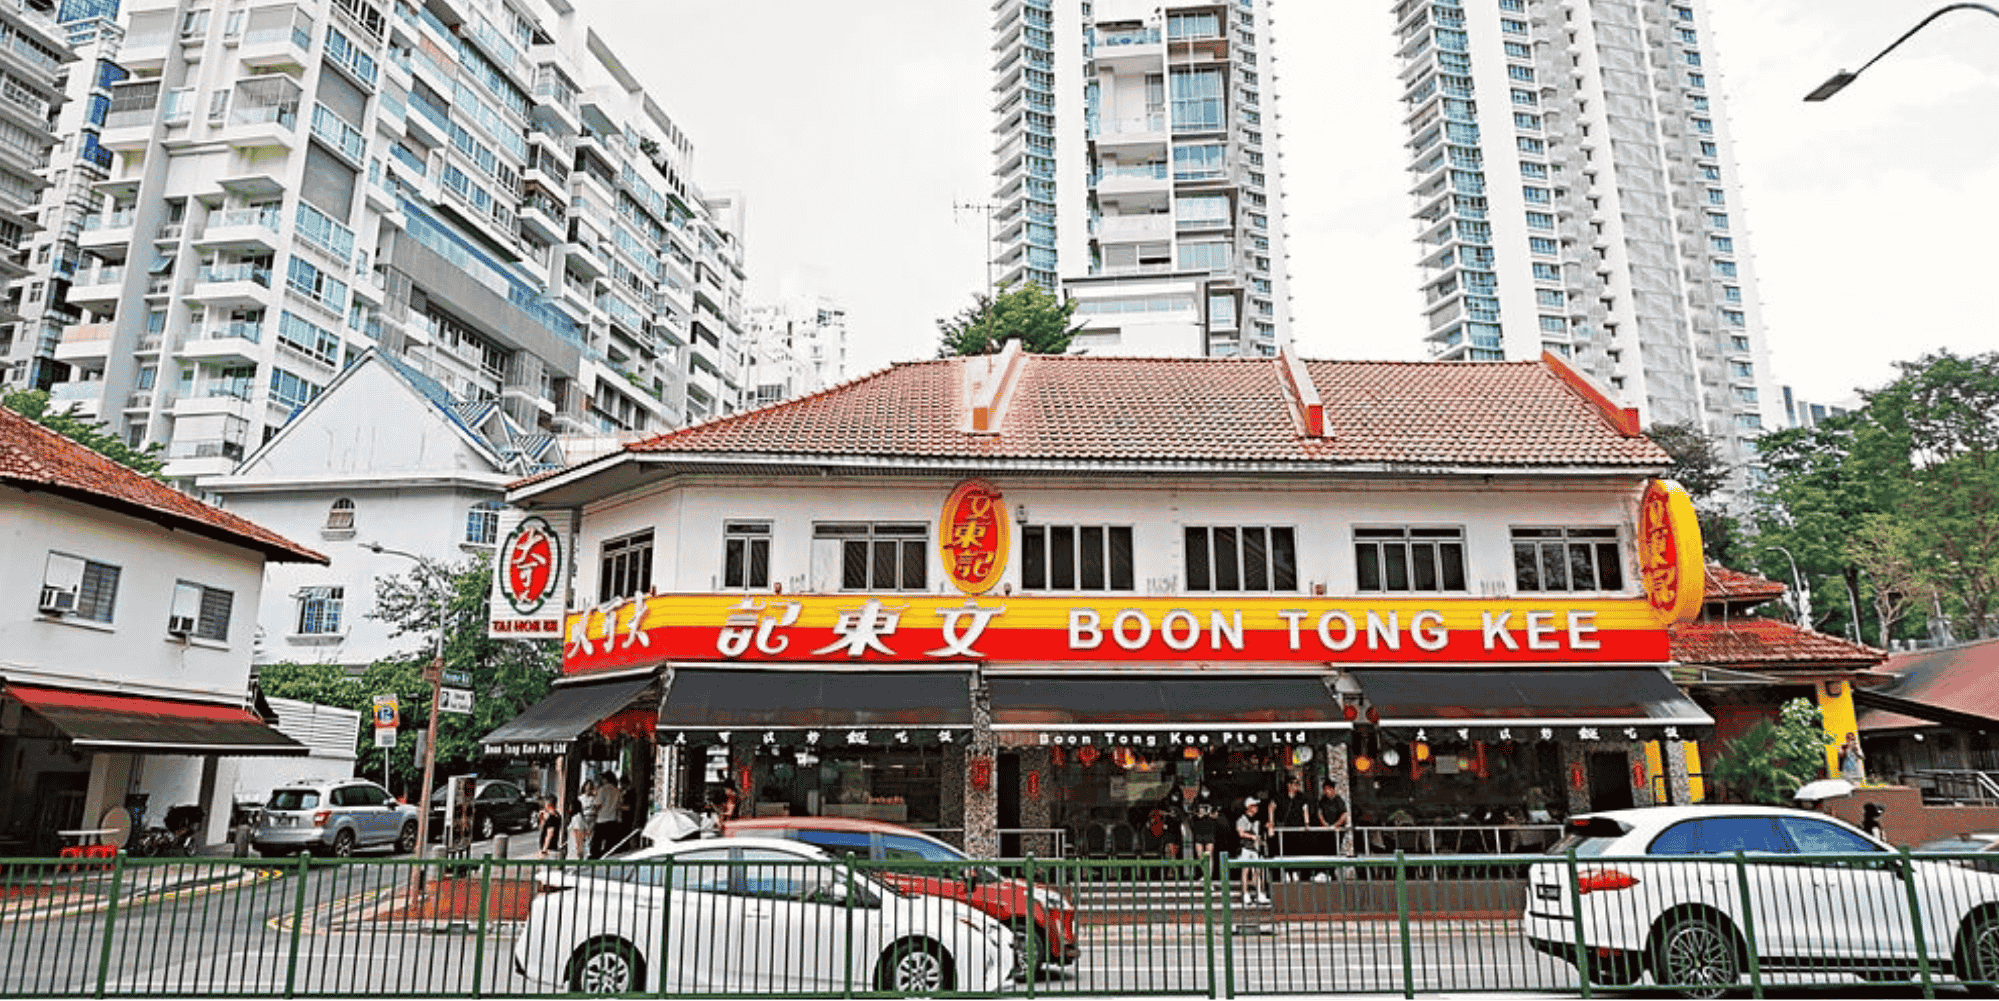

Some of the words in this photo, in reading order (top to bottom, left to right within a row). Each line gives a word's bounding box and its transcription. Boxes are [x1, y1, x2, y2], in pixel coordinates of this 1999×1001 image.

[954, 494, 994, 577] 文東記
[1068, 608, 1244, 651] BOON
[1278, 608, 1450, 651] TONG
[1481, 608, 1601, 651] KEE
[1040, 732, 1092, 745] Boon
[1104, 731, 1157, 747] Tong
[1271, 730, 1305, 744] Ltd
